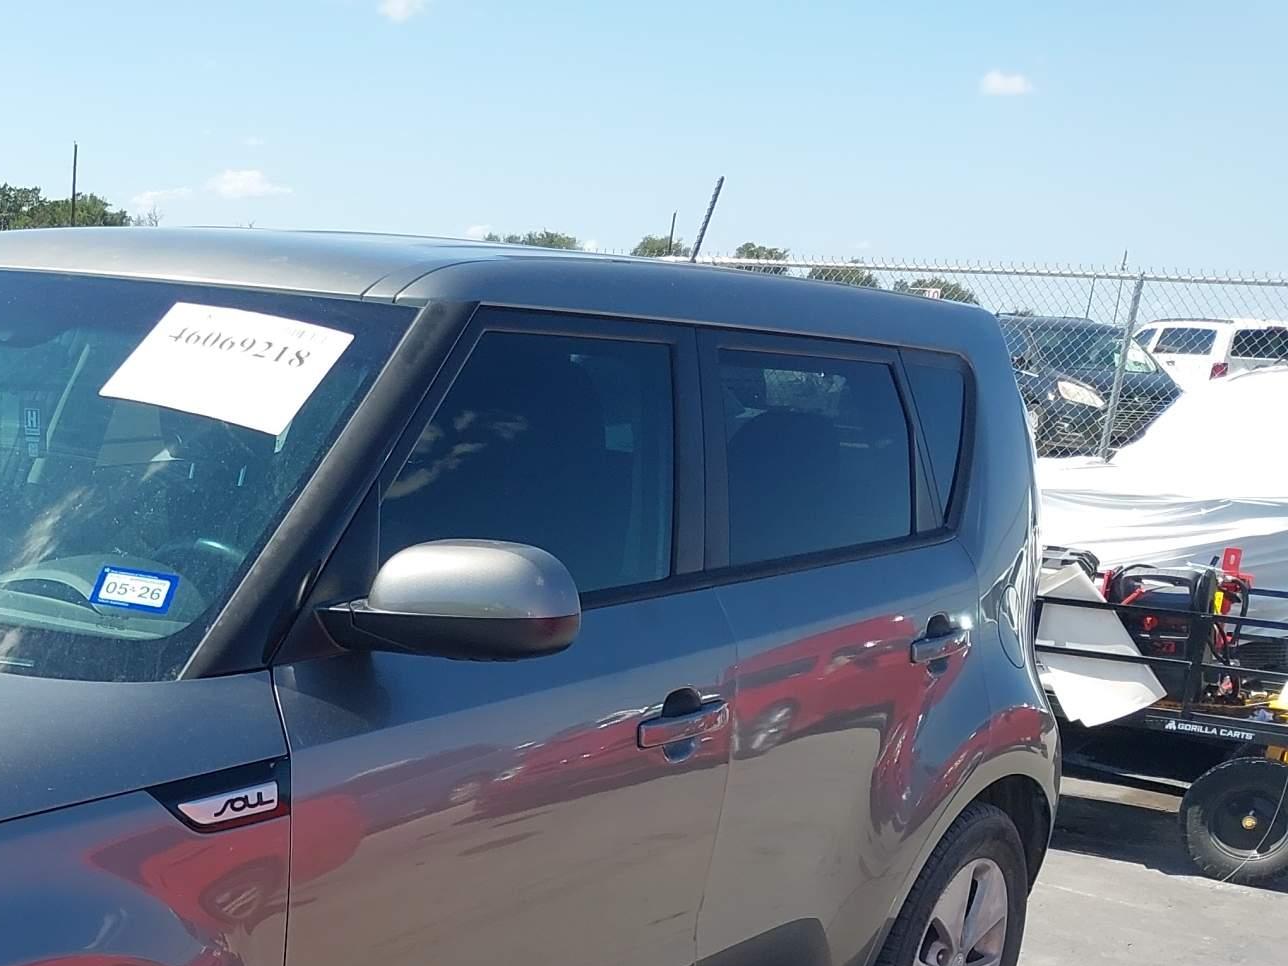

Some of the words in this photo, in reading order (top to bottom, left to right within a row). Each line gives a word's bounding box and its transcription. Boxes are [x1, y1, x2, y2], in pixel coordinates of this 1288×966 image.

[169, 327, 311, 368] 46069218
[1177, 723, 1218, 736] GORILLA
[1219, 728, 1254, 740] CARTS
[213, 791, 275, 817] SOUL
